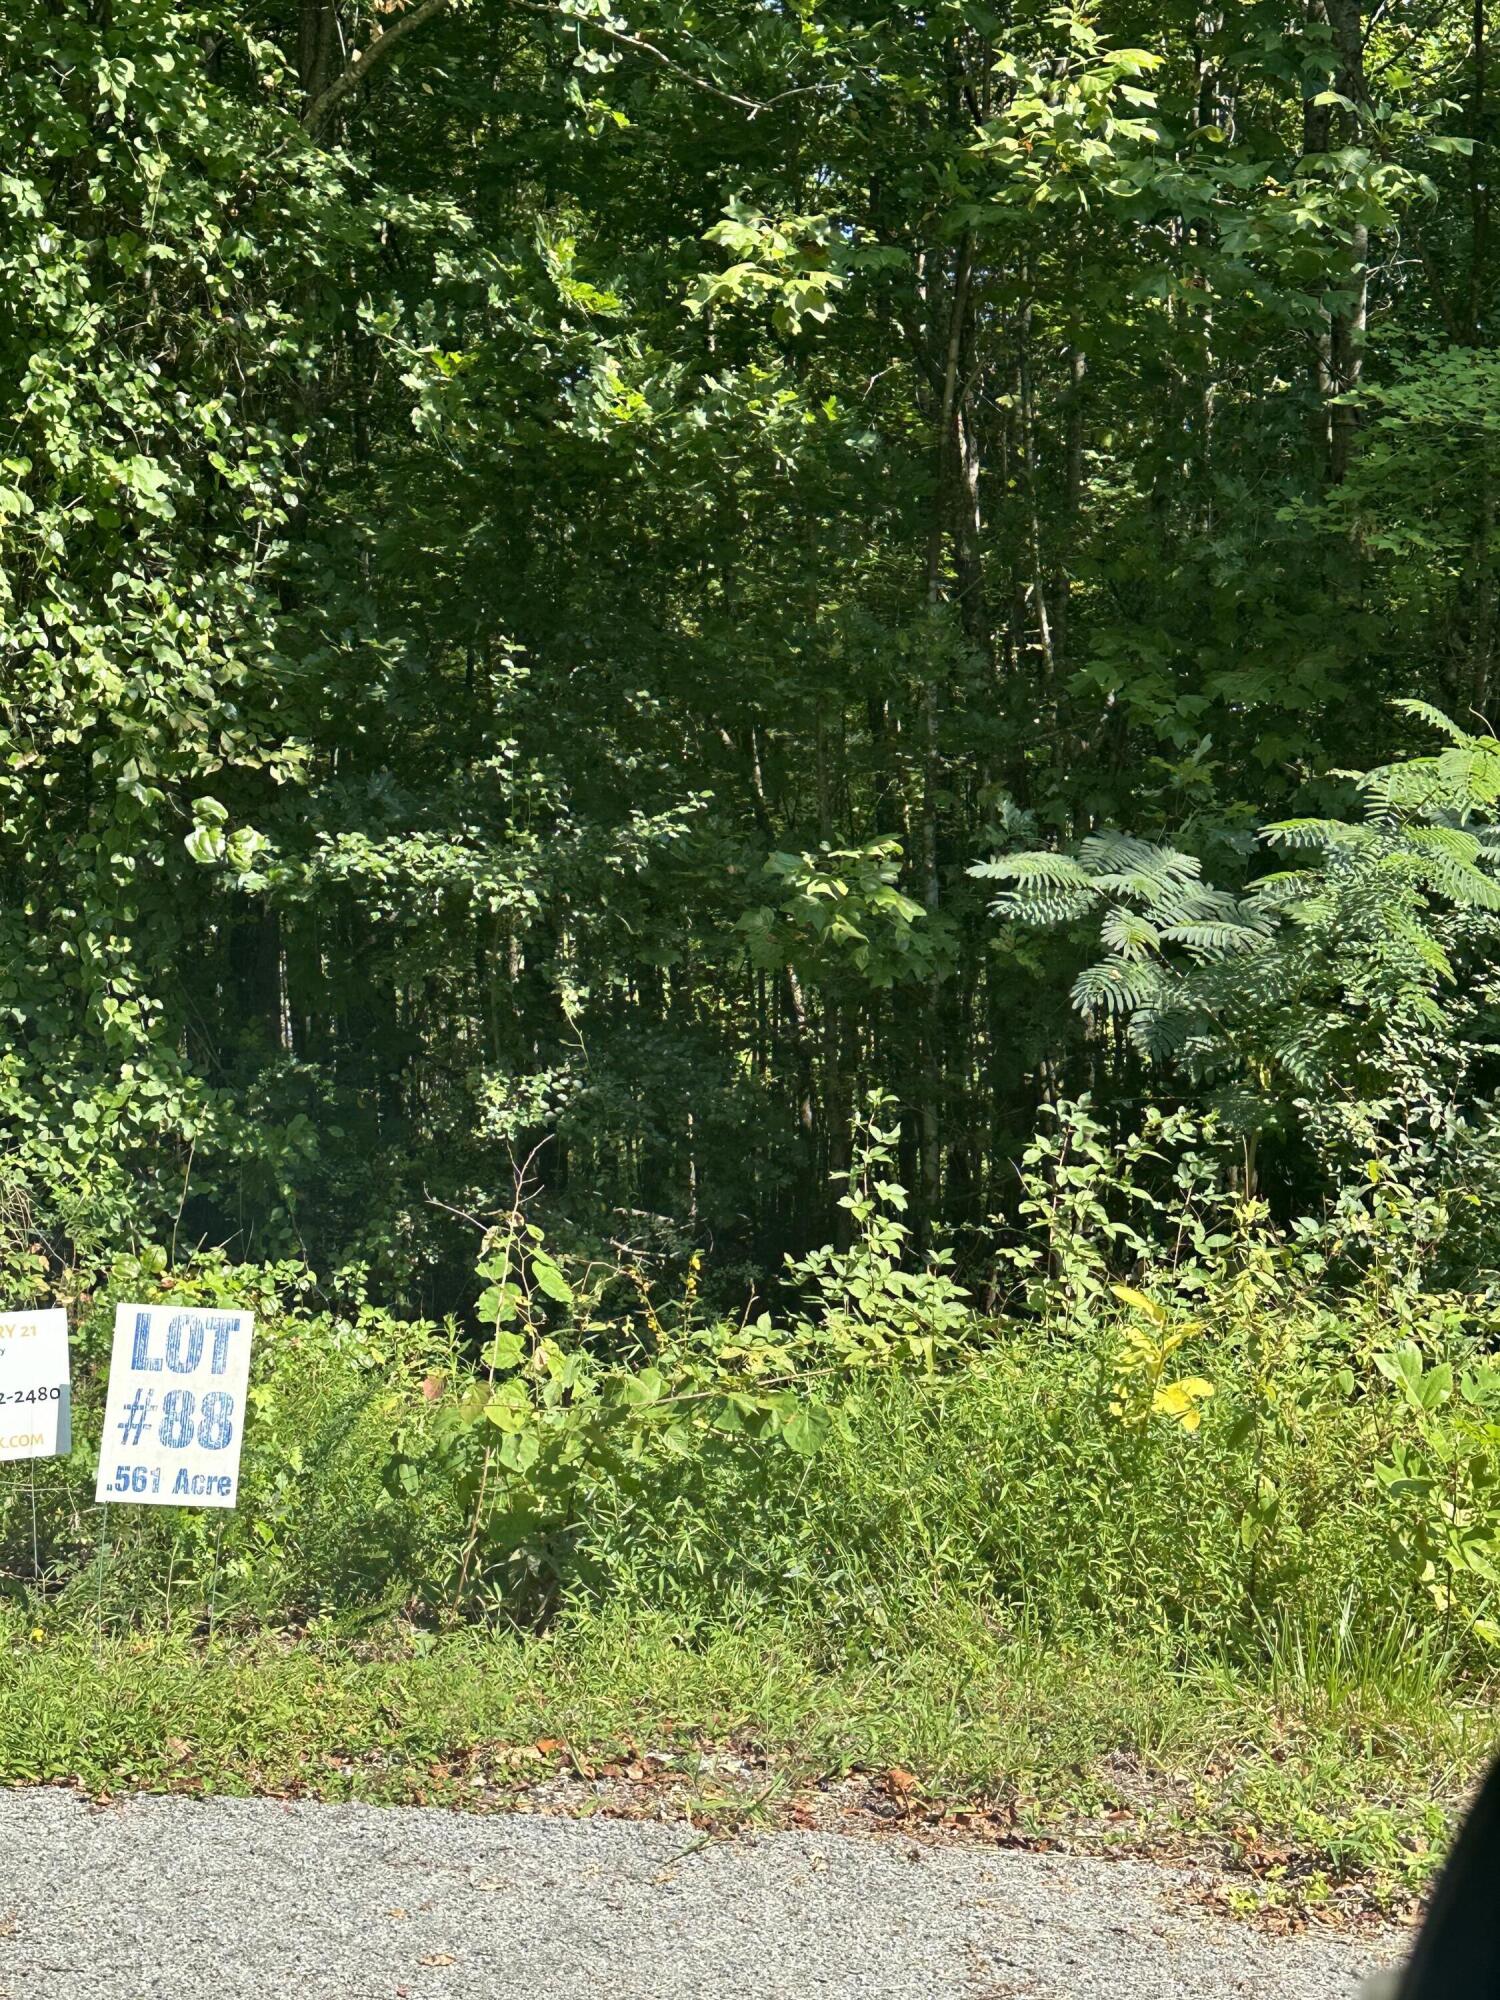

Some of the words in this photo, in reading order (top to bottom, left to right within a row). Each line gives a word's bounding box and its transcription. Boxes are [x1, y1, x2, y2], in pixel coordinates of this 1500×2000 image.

[20, 1325, 37, 1337] 21
[131, 1312, 241, 1375] LOT
[117, 1387, 235, 1450] #88
[106, 1465, 162, 1494] .561
[171, 1468, 232, 1497] Acre
